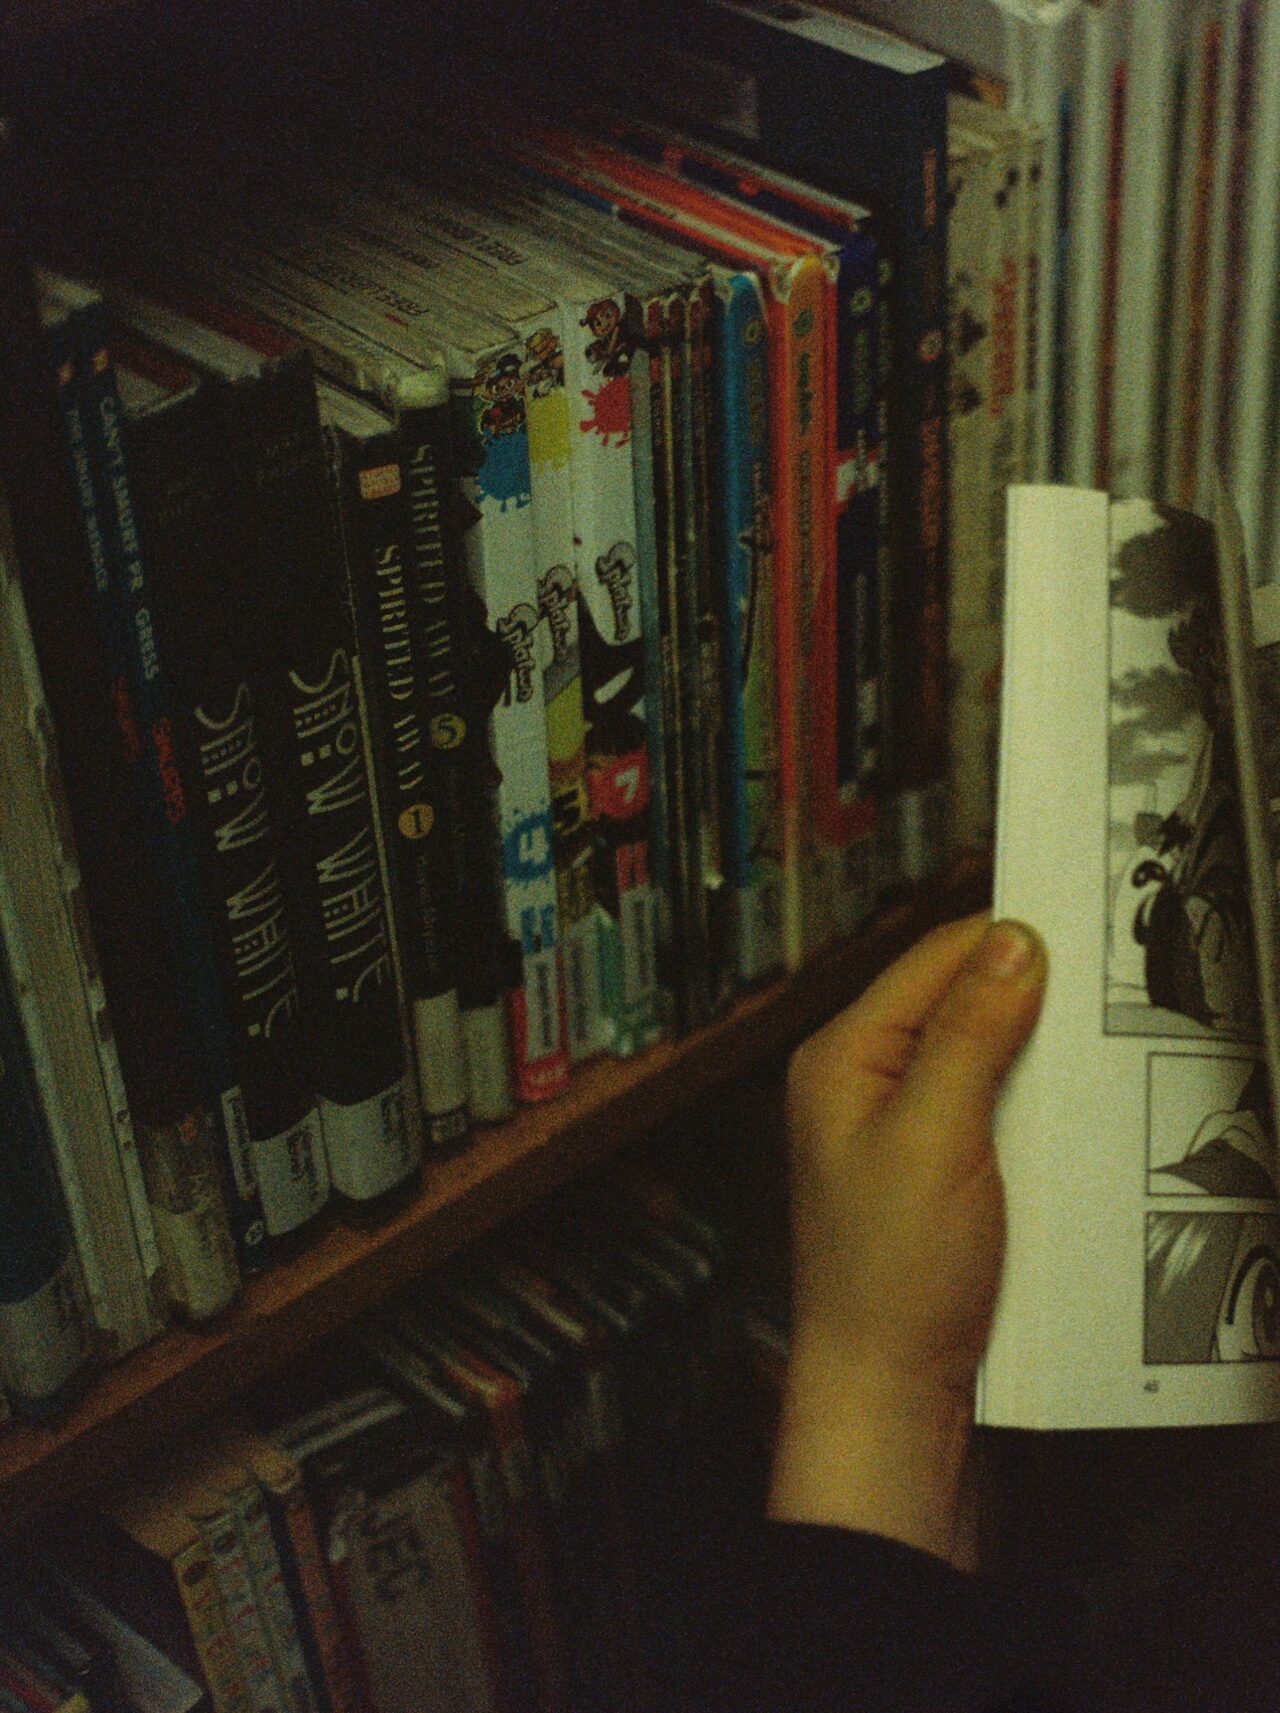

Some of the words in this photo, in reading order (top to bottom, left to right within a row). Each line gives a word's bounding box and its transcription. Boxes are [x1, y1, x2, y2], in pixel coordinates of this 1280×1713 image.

[100, 396, 124, 467] CAN'T
[111, 472, 142, 555] SMURF
[409, 443, 447, 605] SPIRITED
[374, 543, 415, 701] SPIRITED
[423, 618, 457, 697] AWAY
[194, 682, 270, 852] SNOW
[288, 648, 368, 816] SNOW
[393, 713, 424, 791] AWAY
[435, 718, 457, 745] 5
[412, 810, 425, 832] 1
[614, 765, 641, 804] 7
[518, 824, 550, 864] 4
[226, 860, 298, 1038] WHITE
[315, 826, 393, 1003] WHITE
